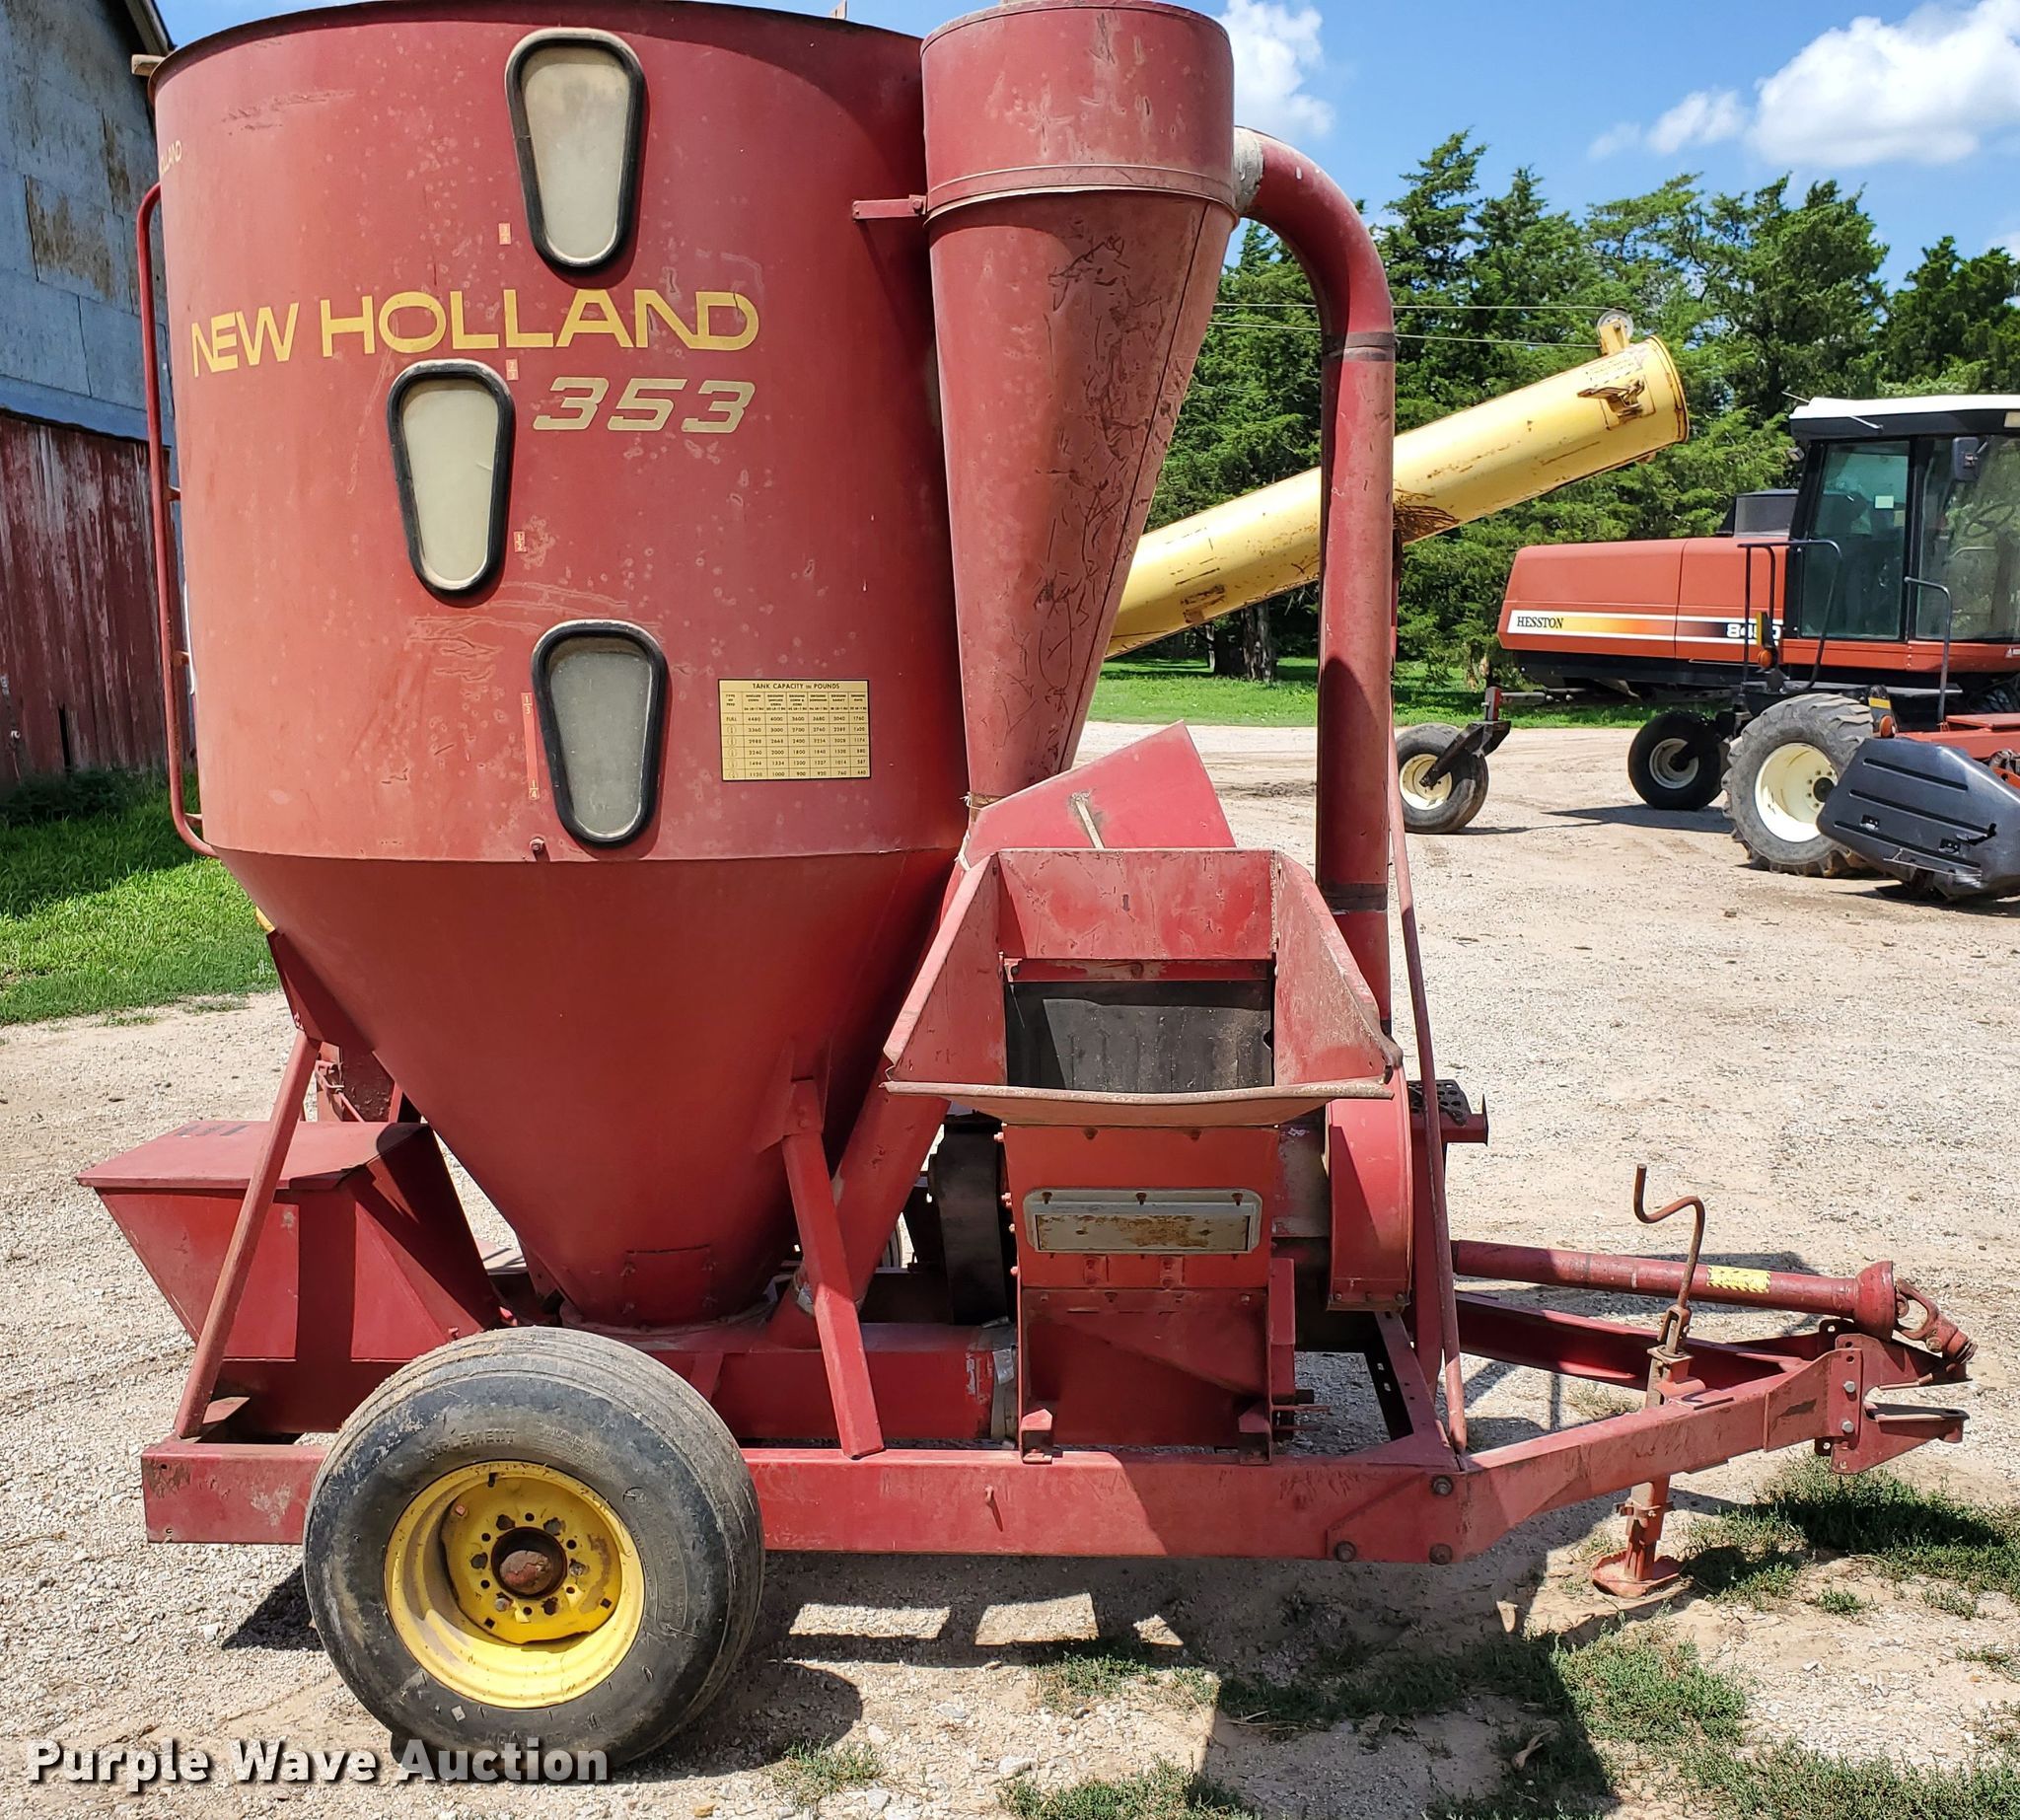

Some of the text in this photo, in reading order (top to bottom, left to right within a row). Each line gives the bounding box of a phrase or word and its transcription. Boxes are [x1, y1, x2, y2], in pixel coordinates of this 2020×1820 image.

[191, 288, 760, 378] NEW HOLLAND
[532, 376, 757, 433] 353
[1517, 617, 1563, 628] HESSTON
